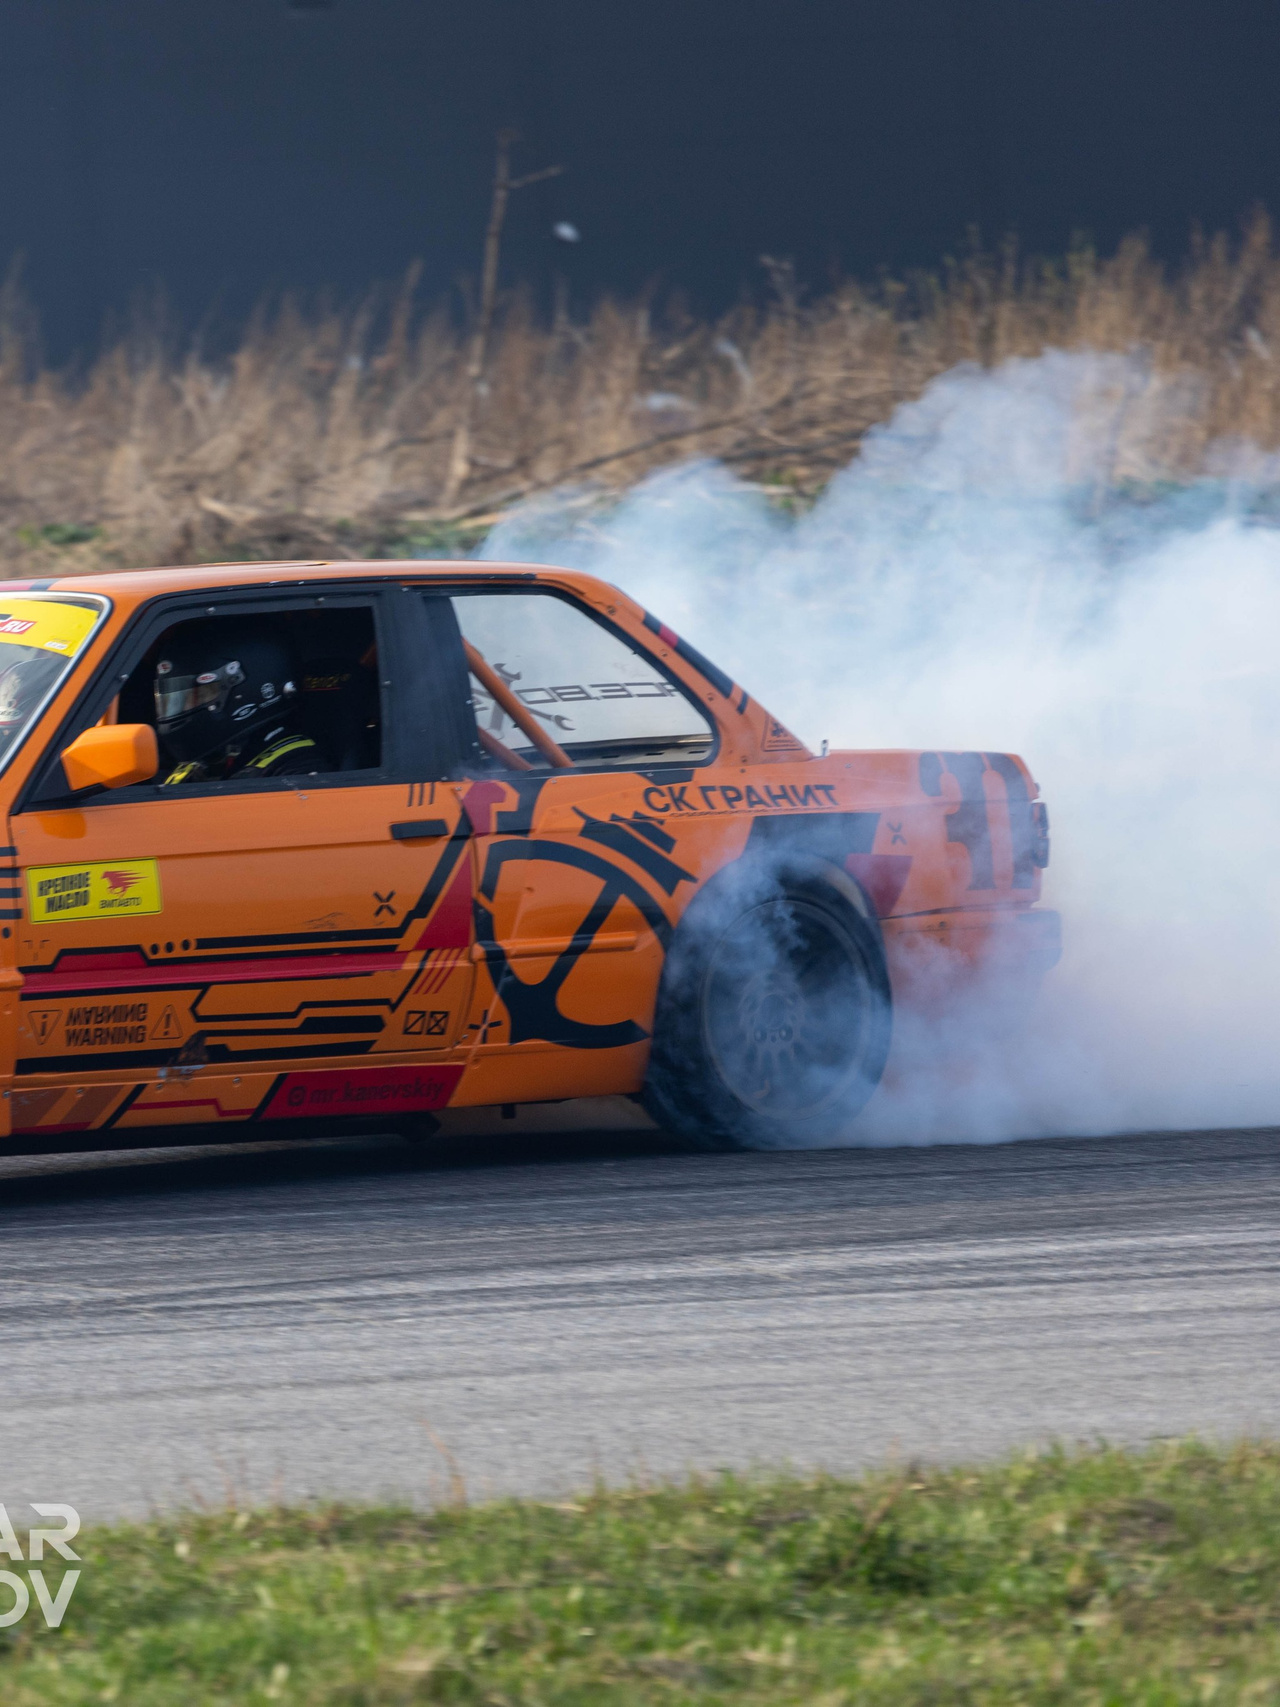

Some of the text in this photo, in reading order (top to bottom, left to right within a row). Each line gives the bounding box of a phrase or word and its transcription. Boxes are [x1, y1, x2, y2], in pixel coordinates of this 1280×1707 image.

[643, 783, 840, 812] СК ГРАНИТ
[65, 1025, 147, 1047] WARNING
